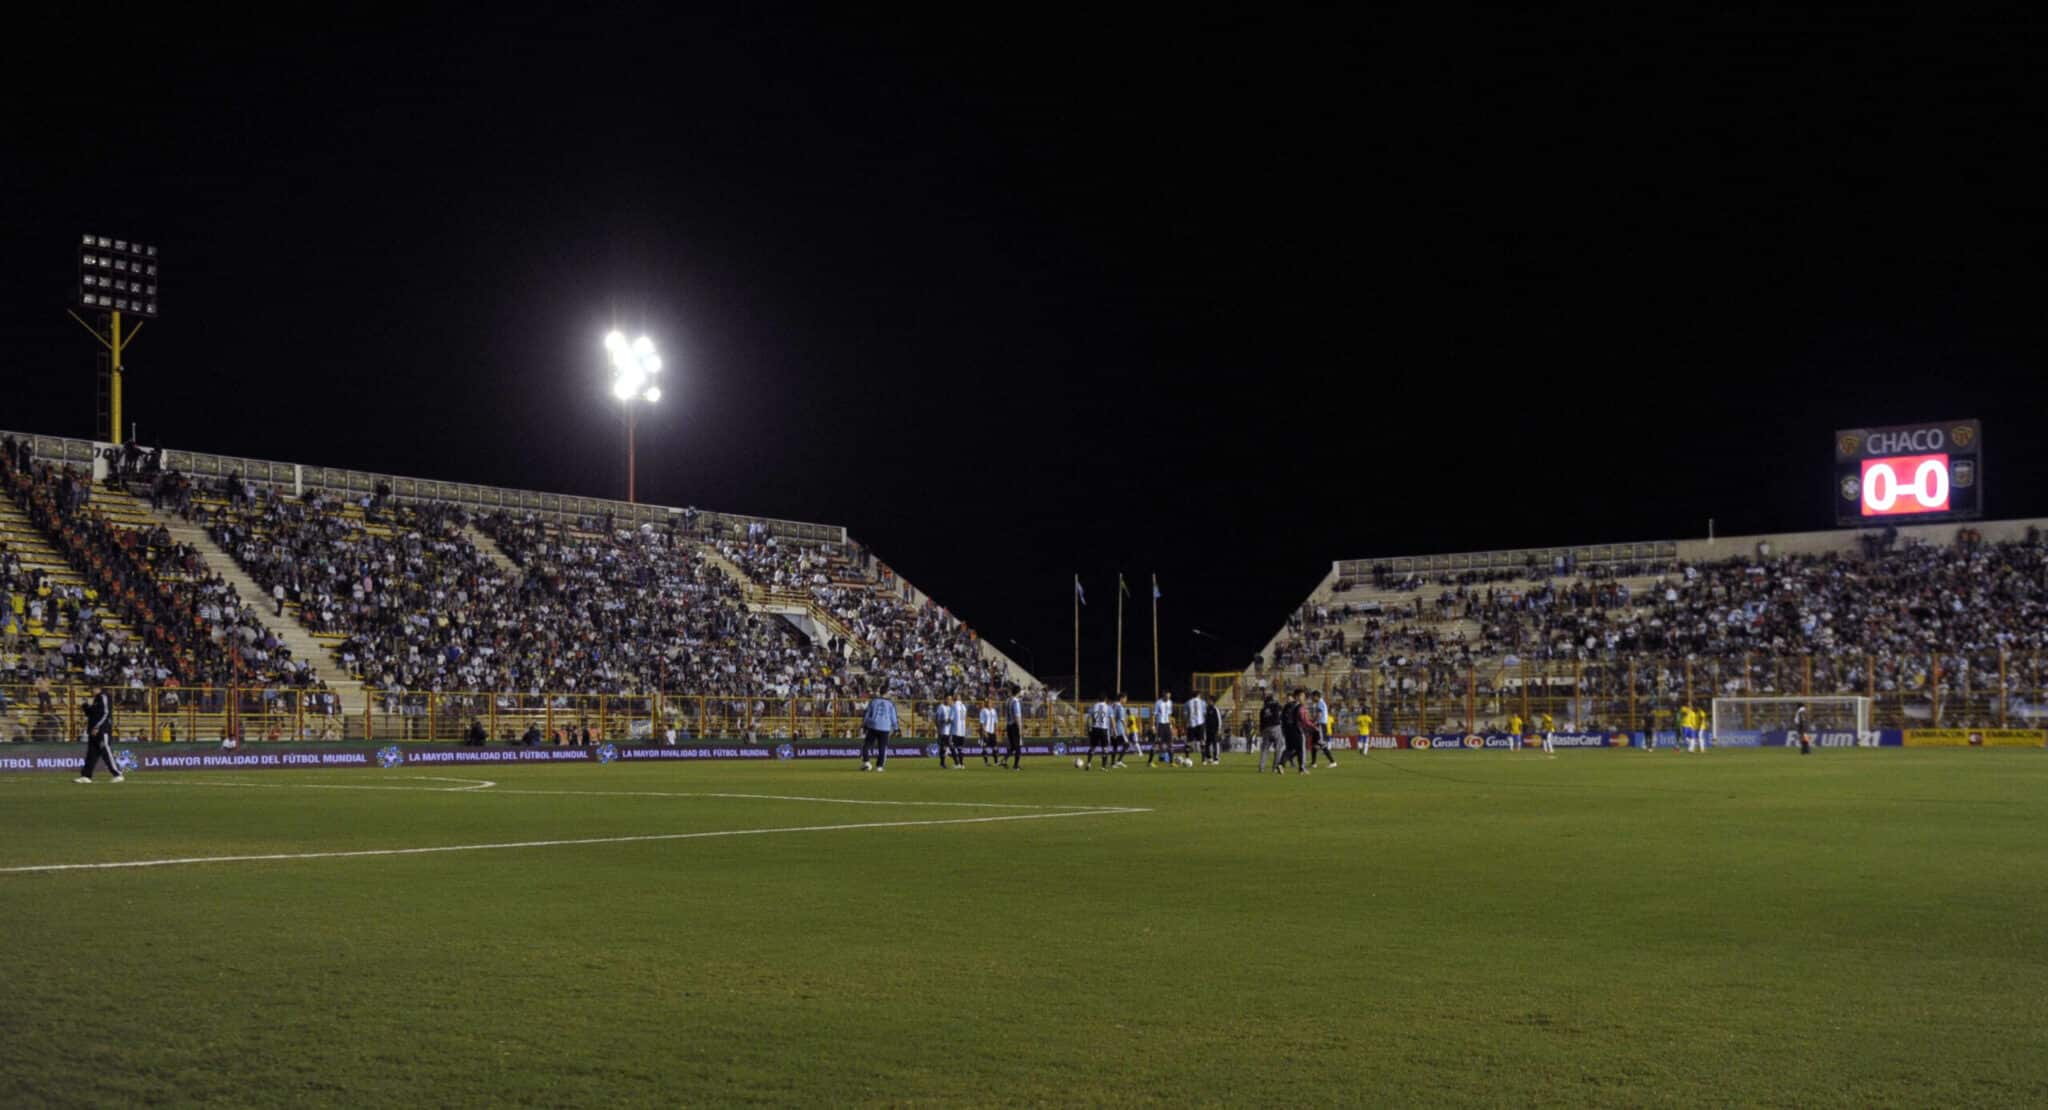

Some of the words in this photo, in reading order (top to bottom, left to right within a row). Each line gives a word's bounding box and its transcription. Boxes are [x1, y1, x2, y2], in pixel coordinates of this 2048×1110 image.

[1867, 429, 1944, 455] CHACO
[1863, 459, 1949, 511] 0-0
[1331, 736, 1351, 748] HMA
[1369, 736, 1398, 748] AHMA
[1551, 735, 1602, 746] MasterCard
[1821, 733, 1853, 747] um
[409, 753, 421, 761] LA
[422, 752, 454, 761] MAYOR
[456, 751, 500, 761] RIVALIDAD
[502, 751, 518, 760] DEL
[520, 749, 550, 759] FÚTBOL
[552, 750, 588, 759] MUNDIAL
[622, 749, 632, 757] LA
[633, 749, 659, 757] MAYOR
[661, 749, 697, 757] RIVALIDAD
[698, 749, 711, 757] DEL
[0, 758, 33, 768] TBOL
[37, 757, 85, 768] MUNDIA
[145, 757, 159, 767] LA
[162, 756, 200, 766] MAYOR
[203, 755, 258, 766] RIVALIDAD
[261, 755, 280, 765] DEL
[283, 753, 320, 764] FÚTBOL
[323, 753, 367, 763] MUNDIAL
